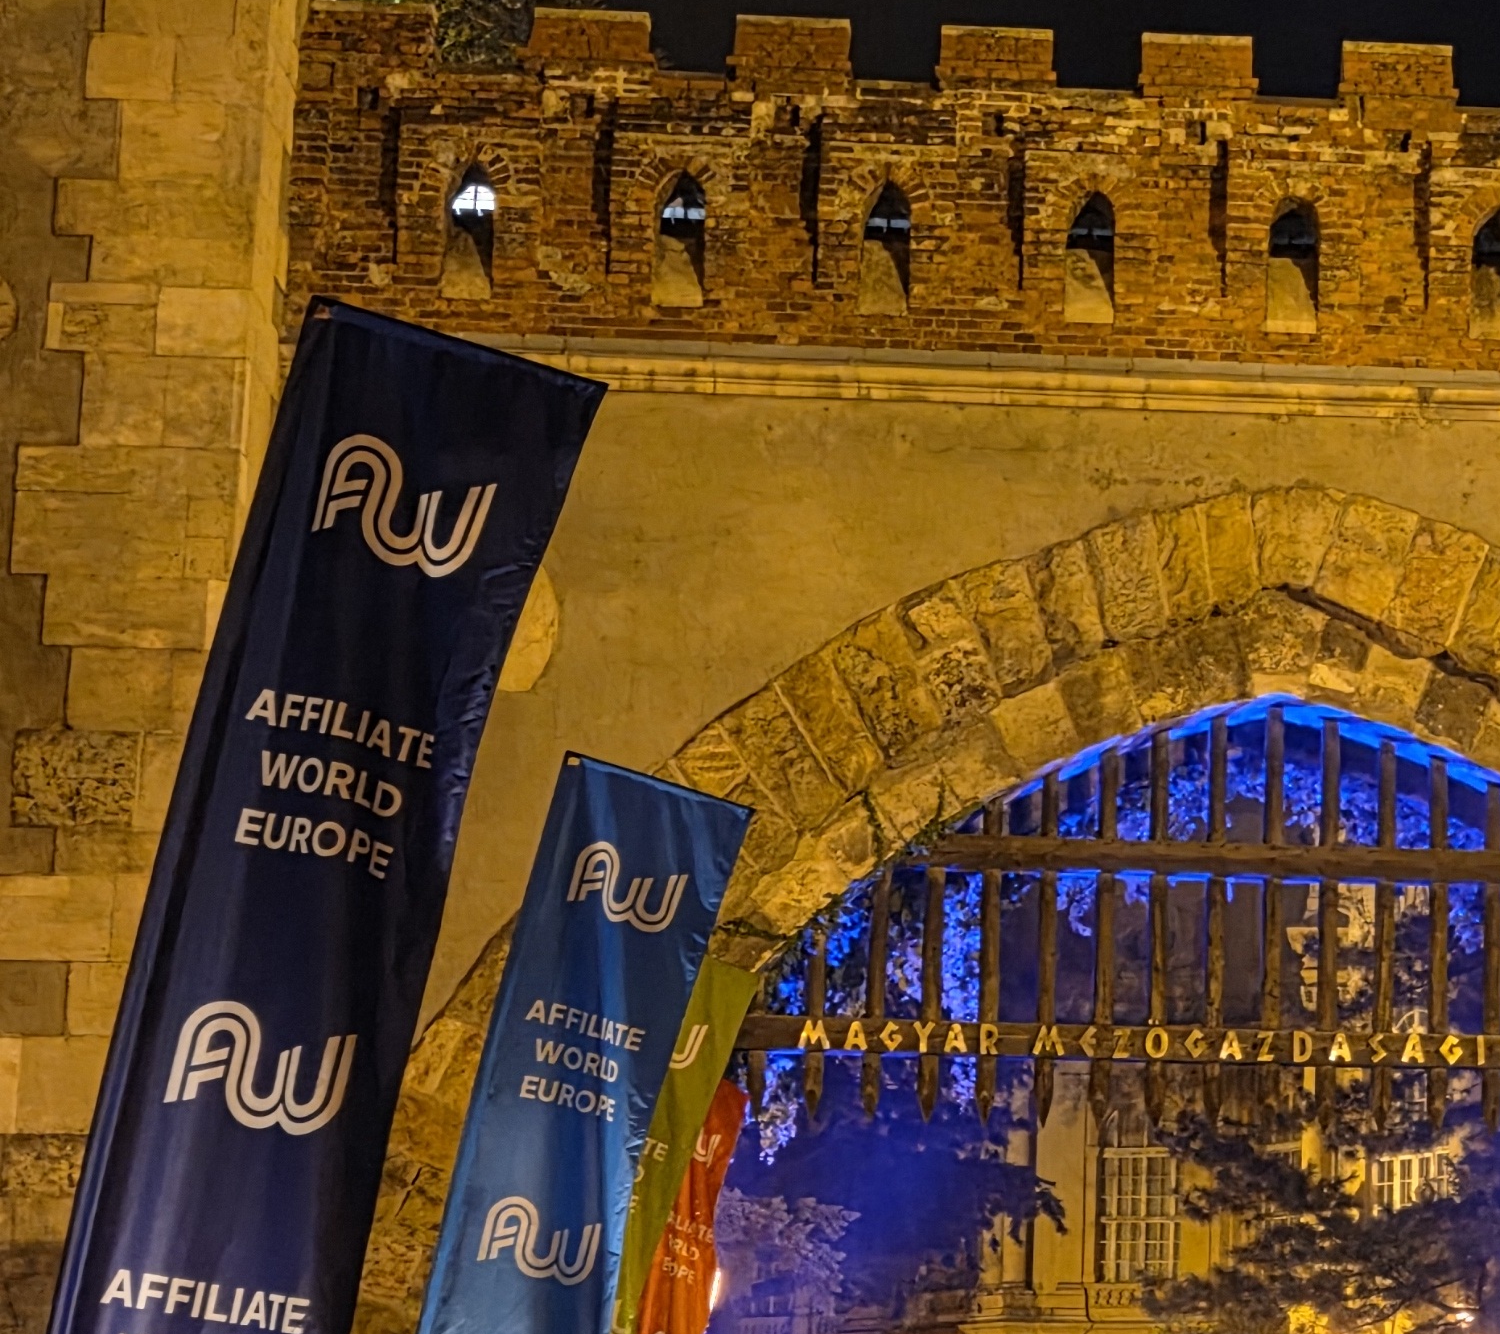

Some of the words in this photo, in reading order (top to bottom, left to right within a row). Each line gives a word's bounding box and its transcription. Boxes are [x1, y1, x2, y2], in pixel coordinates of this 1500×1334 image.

[245, 688, 435, 769] AFFILIATE
[261, 749, 403, 818] WORLD
[234, 808, 395, 880] EUROPE
[524, 999, 646, 1052] AFFILIATE
[797, 1018, 999, 1055] MAGYAR
[535, 1037, 619, 1083] WORLD
[519, 1075, 616, 1123] EUROPE
